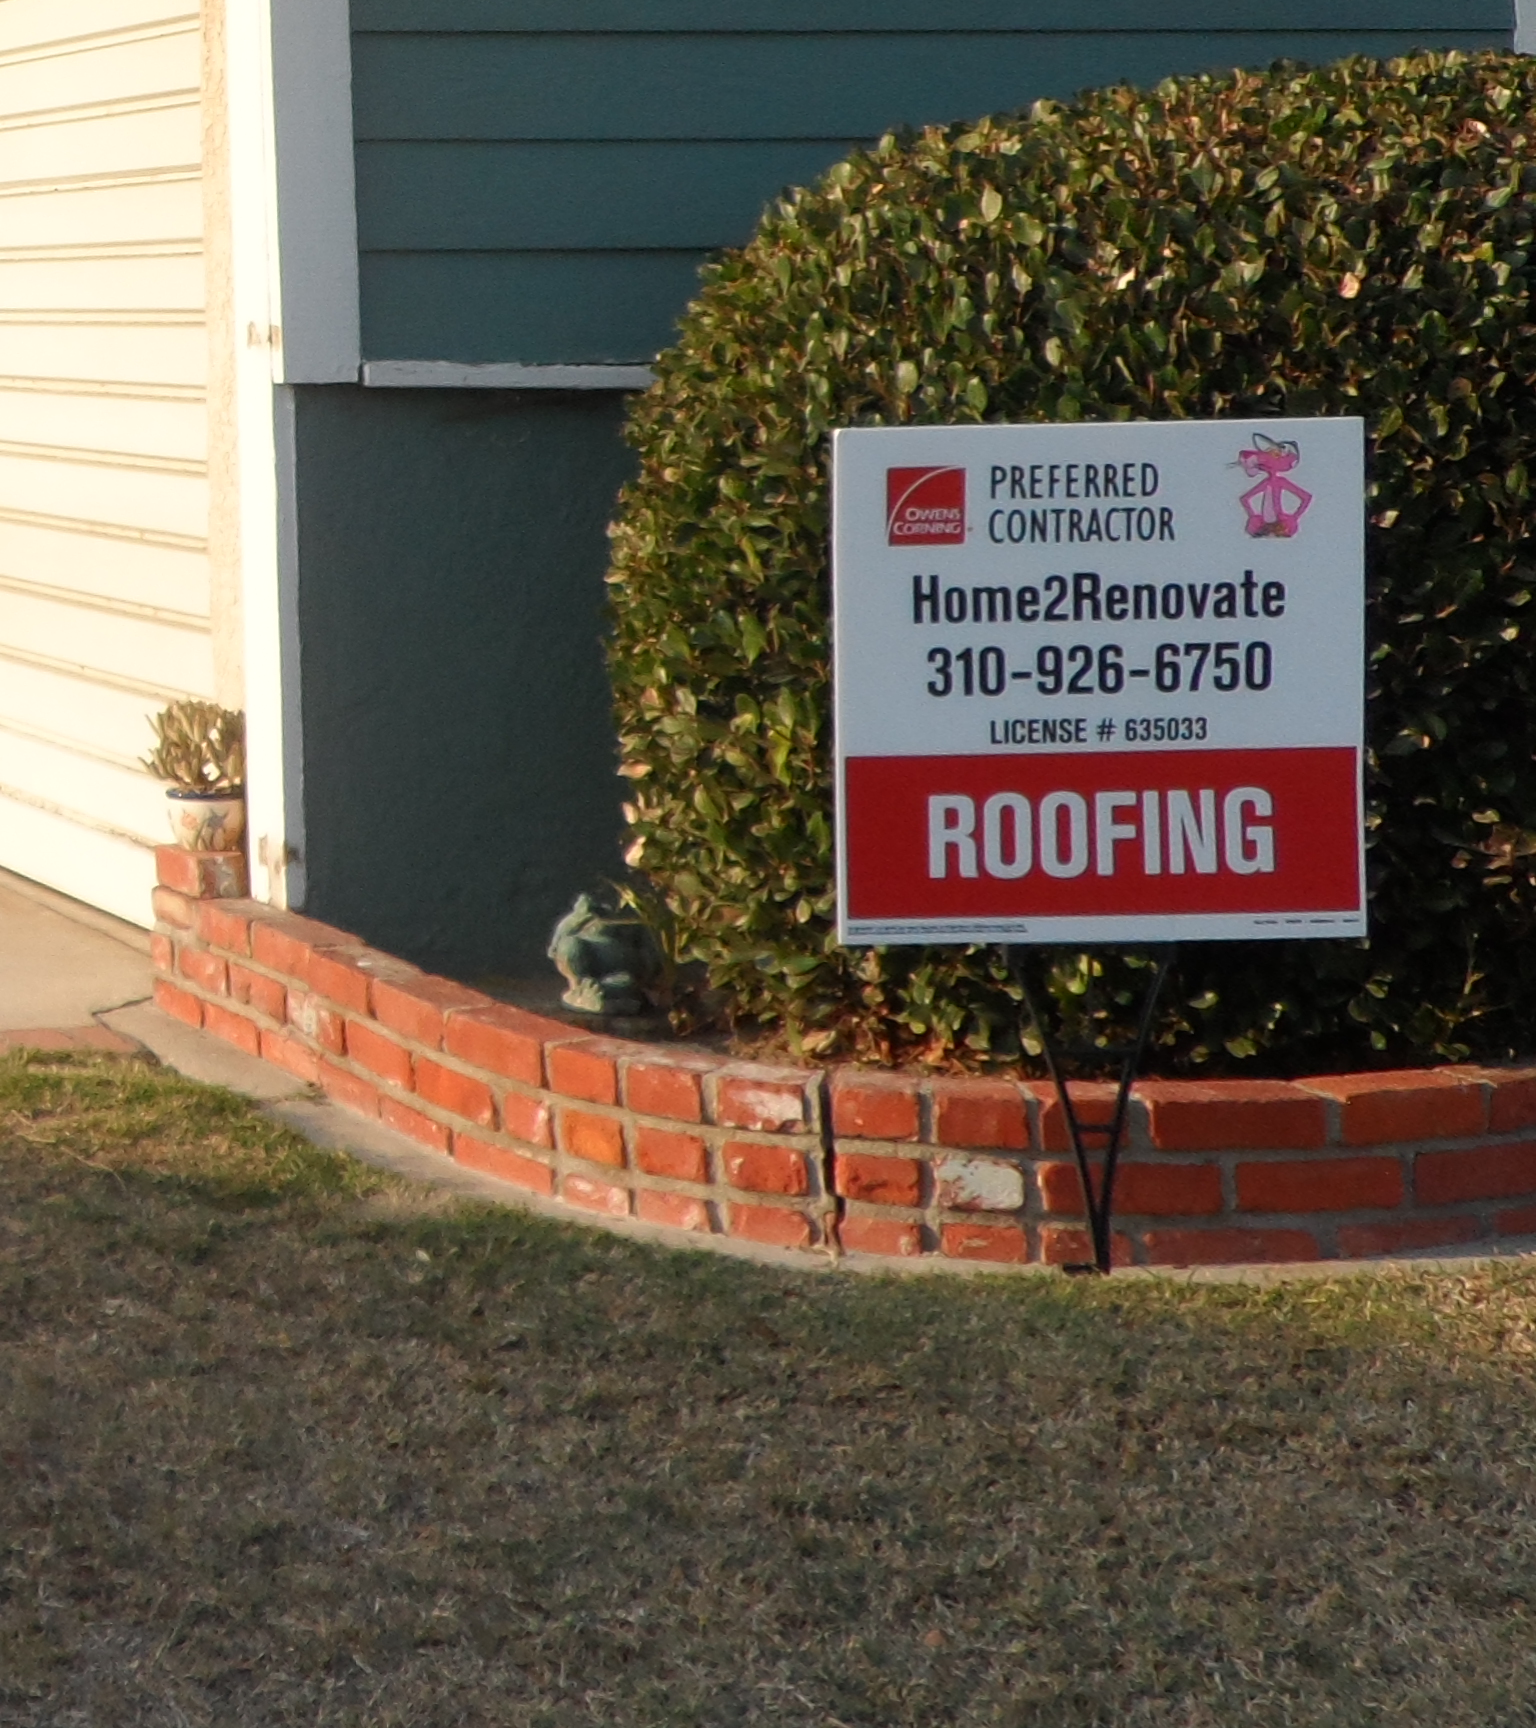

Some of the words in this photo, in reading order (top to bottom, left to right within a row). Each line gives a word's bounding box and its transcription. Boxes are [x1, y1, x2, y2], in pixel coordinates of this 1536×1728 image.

[989, 463, 1159, 499] PREFERRED
[892, 521, 962, 536] CORNING
[905, 507, 962, 521] OWENS
[988, 506, 1175, 544] CONTRACTOR
[912, 570, 1286, 624] Home2Renovate
[926, 641, 1273, 697] 310-926-6750
[989, 719, 1088, 745] LICENSE
[1096, 721, 1116, 743] #
[1124, 716, 1208, 742] 635033
[927, 786, 1275, 879] ROOFING
